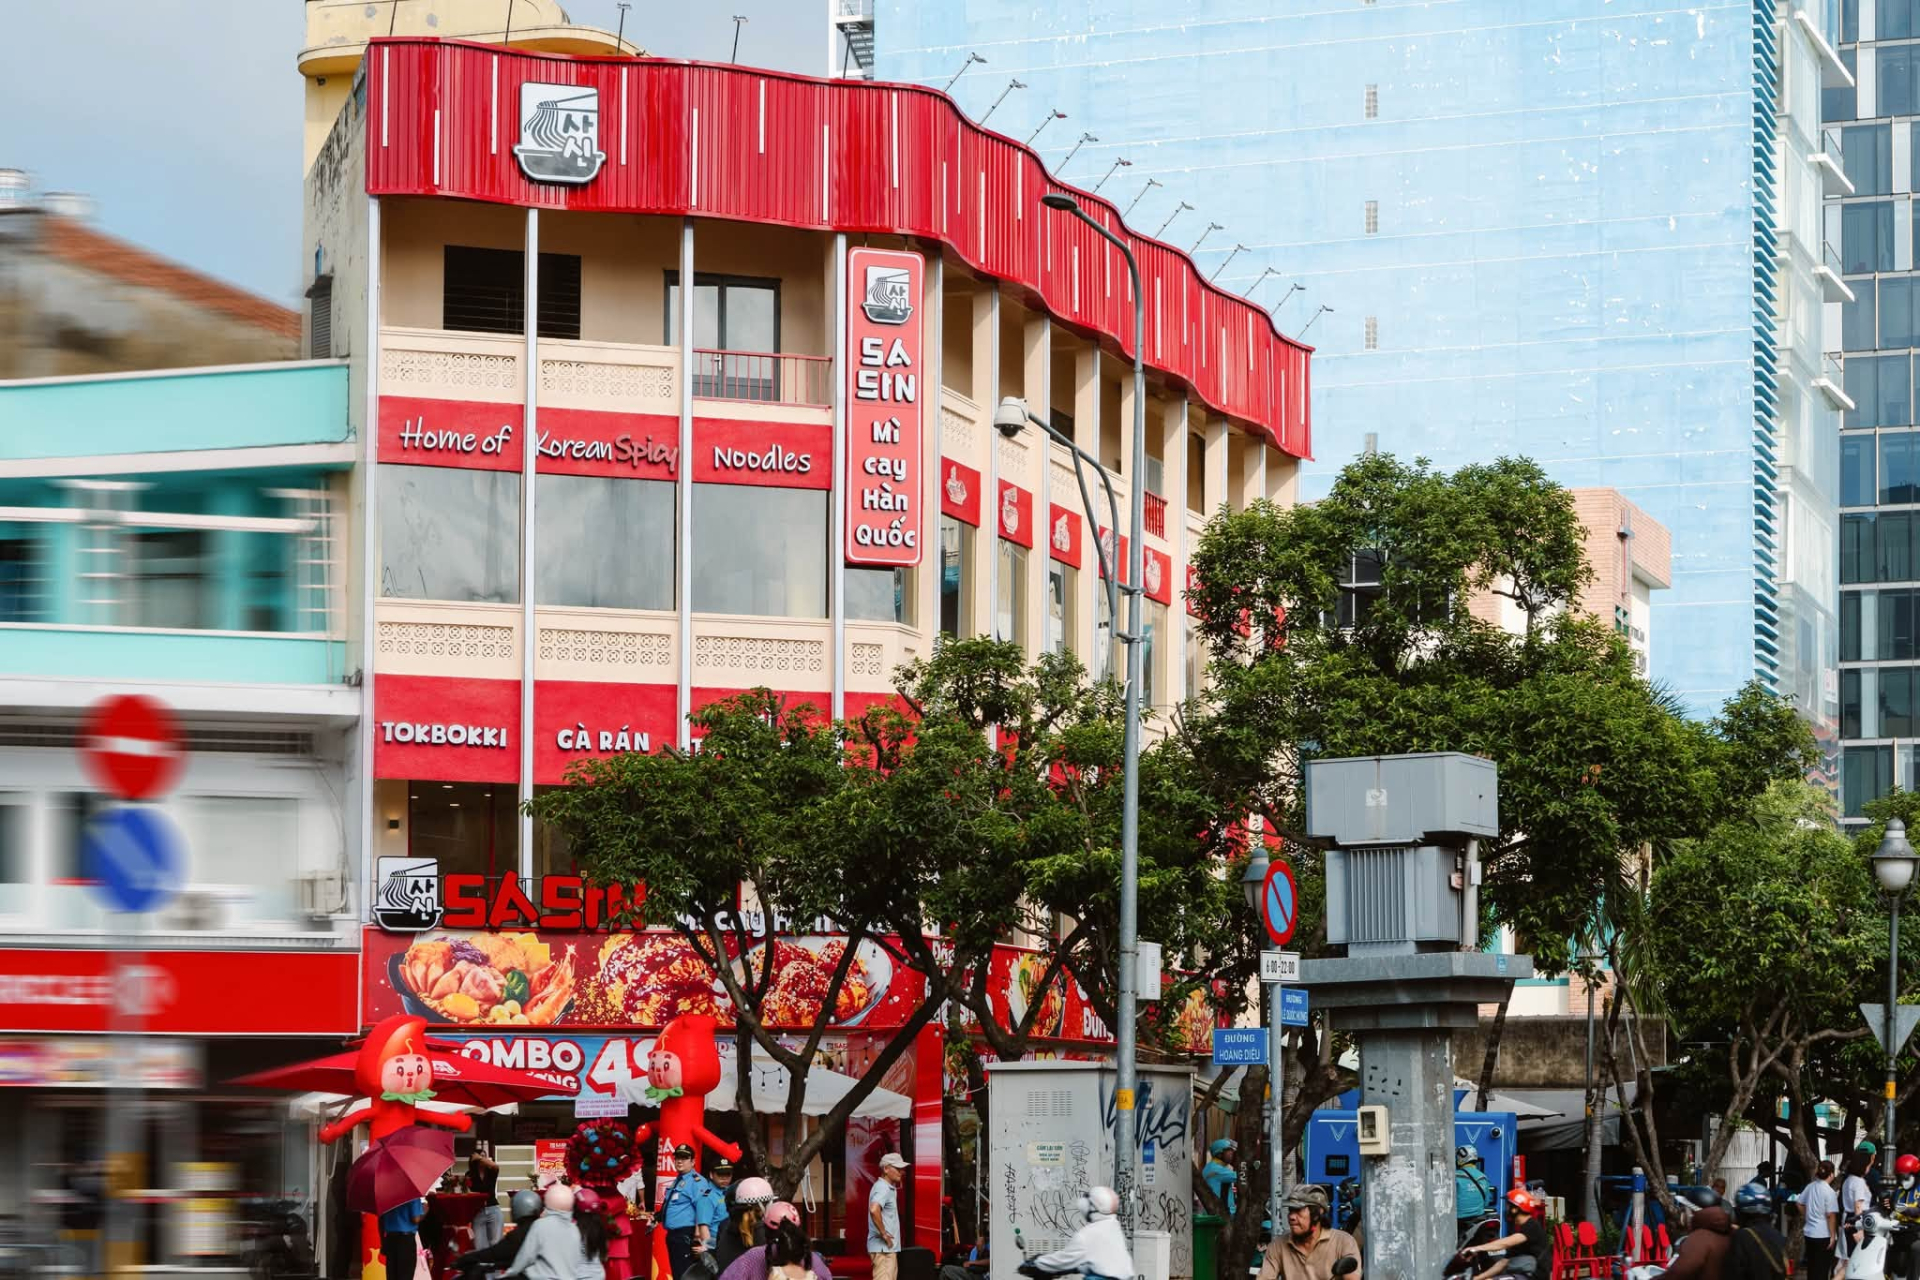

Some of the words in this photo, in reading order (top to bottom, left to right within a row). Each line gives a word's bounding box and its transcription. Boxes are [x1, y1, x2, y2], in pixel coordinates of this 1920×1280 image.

[861, 336, 912, 367] SA
[857, 369, 916, 403] SIN
[399, 416, 477, 453] Home
[481, 424, 513, 454] of
[872, 416, 901, 443] Mì
[535, 430, 613, 461] Korean
[614, 434, 679, 472] Spicy
[714, 444, 812, 473] Noodles
[864, 456, 907, 481] cay
[862, 482, 909, 511] Hàn
[855, 515, 916, 548] Quốc
[382, 721, 508, 748] TOKBOKKI
[556, 721, 592, 750] GÀ
[598, 723, 651, 752] RÁN
[1224, 1032, 1256, 1043] ĐƯỜNG
[452, 1039, 582, 1072] OMBO
[1219, 1046, 1243, 1061] HOÀNG
[1244, 1046, 1261, 1062] DIỆU
